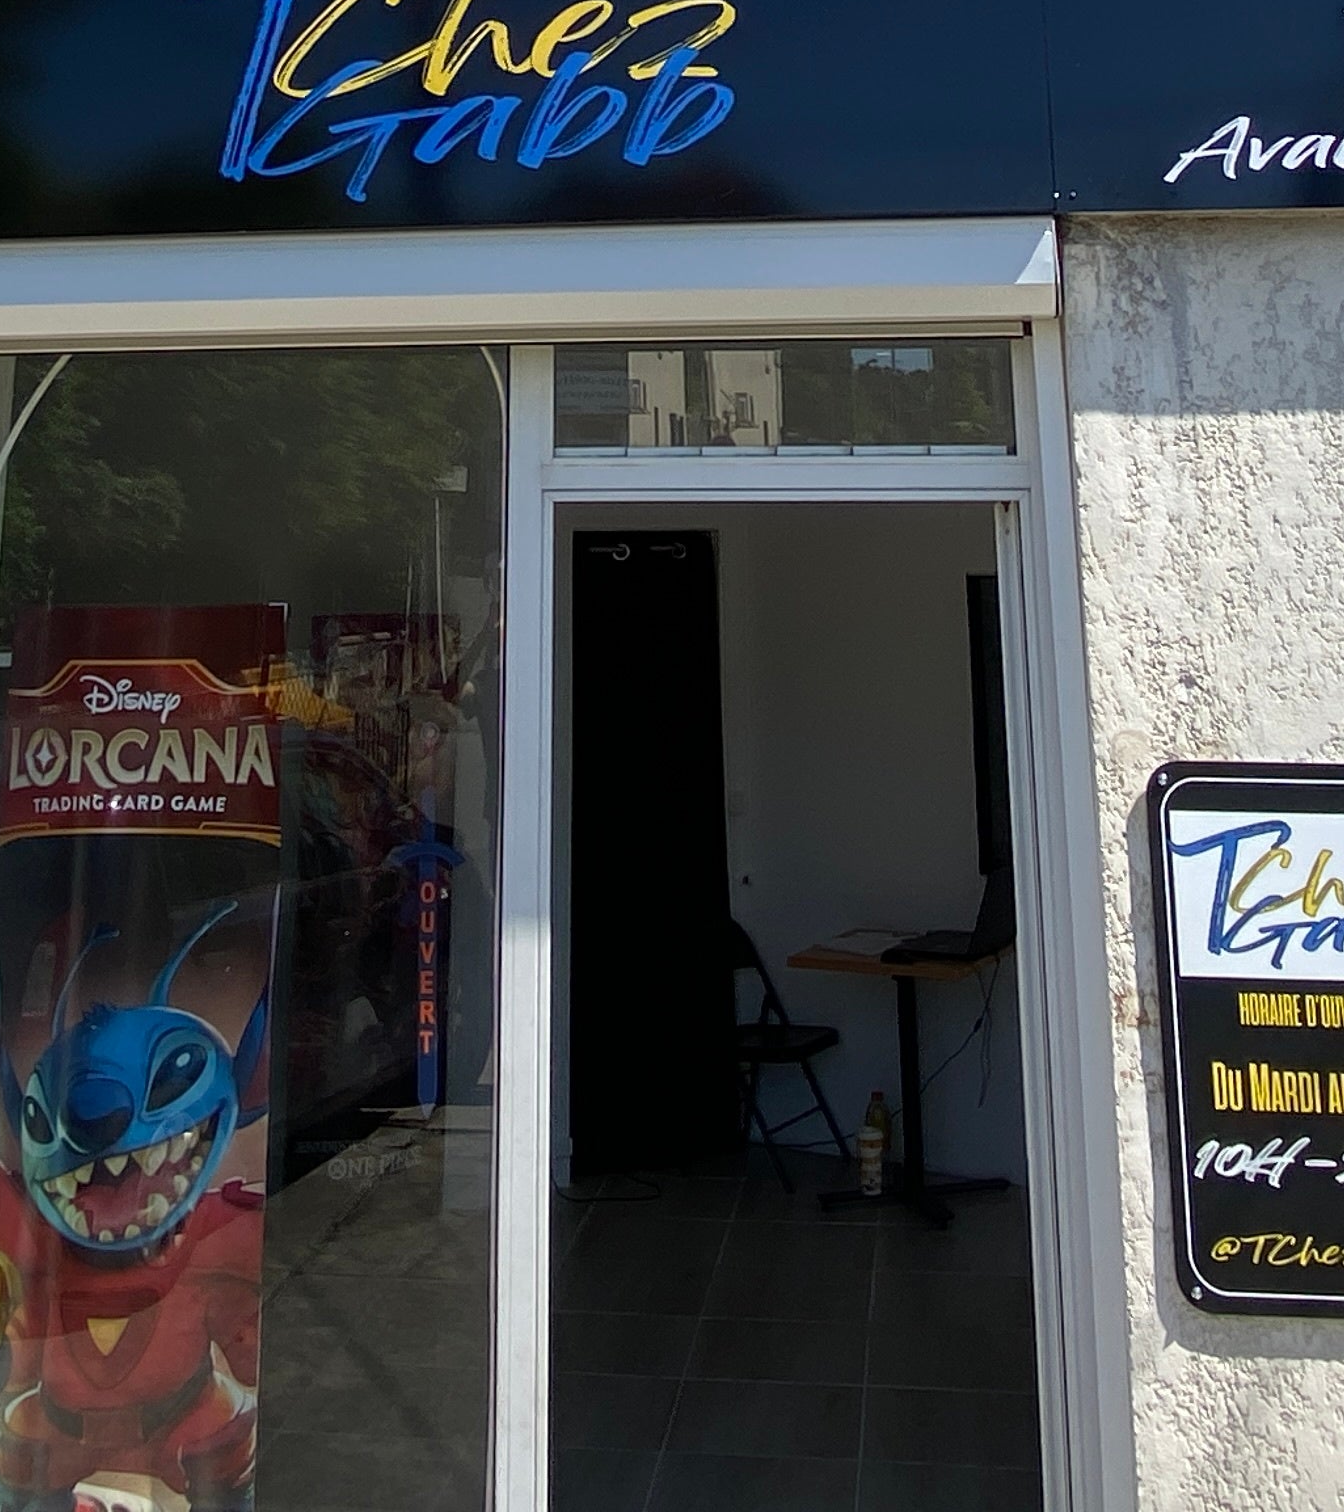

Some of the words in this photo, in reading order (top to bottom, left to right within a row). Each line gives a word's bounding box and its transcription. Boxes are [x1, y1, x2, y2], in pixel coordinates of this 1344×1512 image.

[247, 49, 736, 203] Gabb
[9, 724, 276, 790] LORCANA
[33, 796, 105, 813] TRADING
[110, 795, 164, 812] CARD
[170, 795, 228, 813] GAME
[418, 882, 435, 1054] OUVERT
[1238, 992, 1302, 1028] HORAIRE
